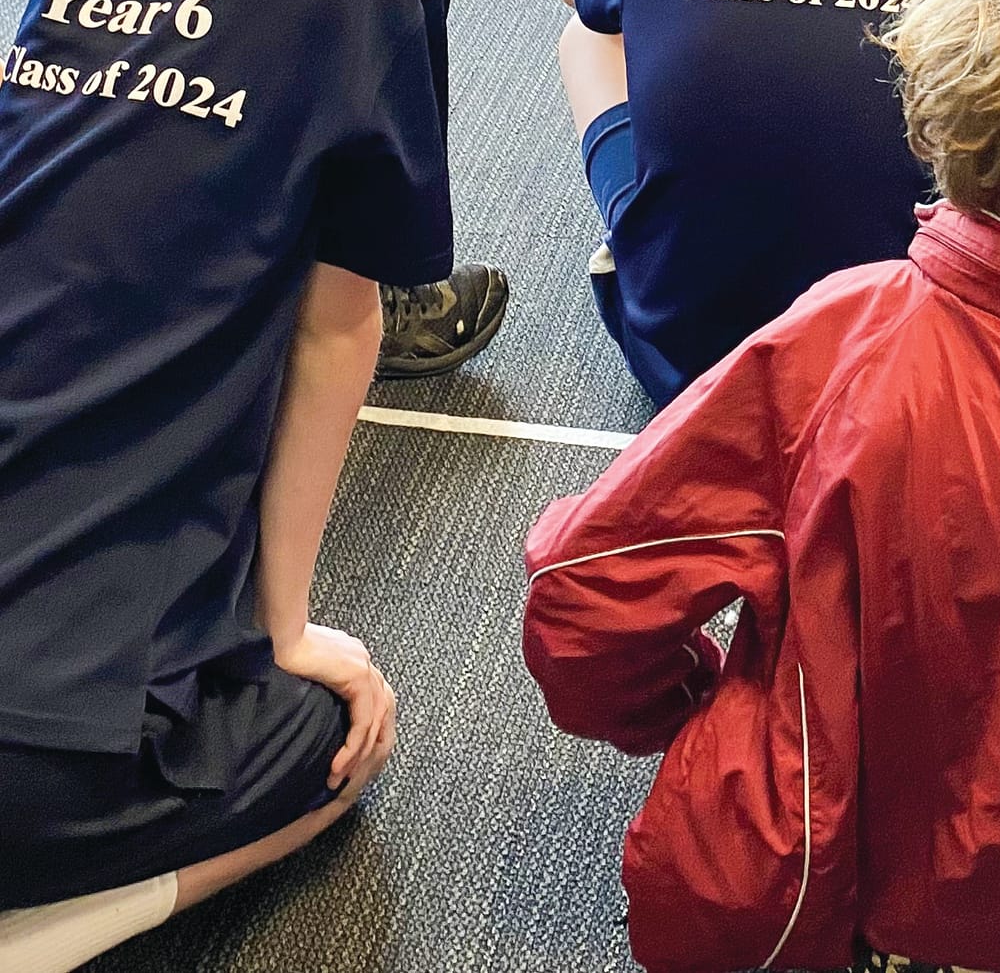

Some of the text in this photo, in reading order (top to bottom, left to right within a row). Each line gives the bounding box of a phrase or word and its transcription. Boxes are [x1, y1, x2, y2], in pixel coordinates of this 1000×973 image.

[3, 44, 247, 129] Class of 2024
